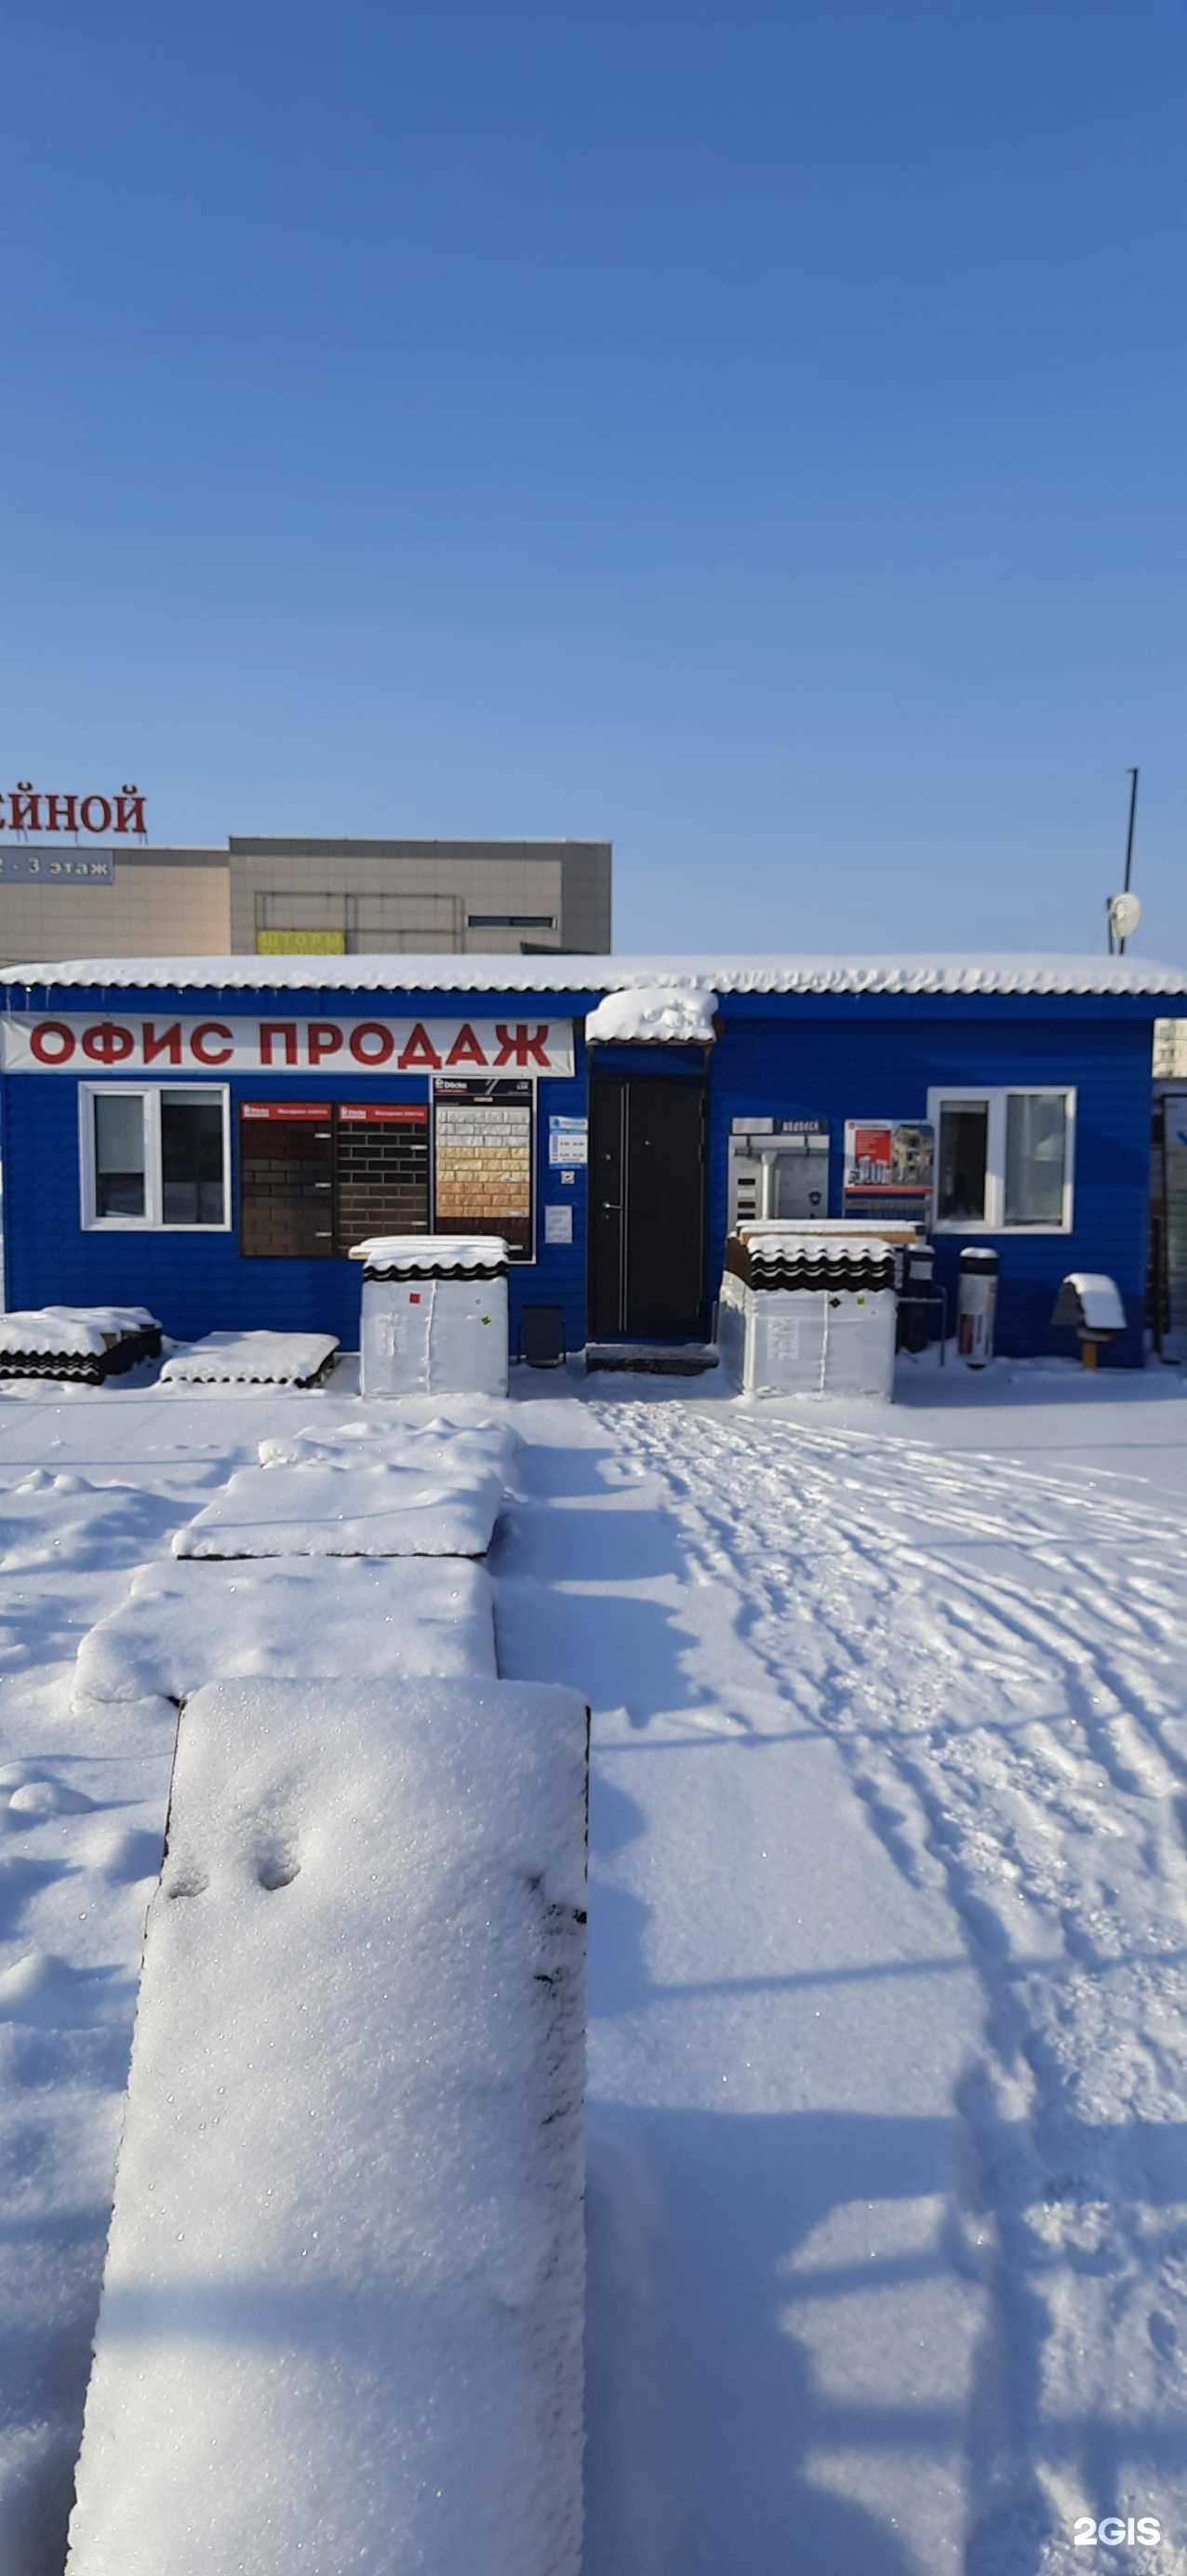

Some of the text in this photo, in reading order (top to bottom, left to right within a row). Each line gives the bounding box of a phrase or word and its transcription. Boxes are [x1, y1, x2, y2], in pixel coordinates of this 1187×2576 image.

[28, 857, 40, 874] 3
[49, 862, 109, 877] этаж
[30, 1022, 552, 1069] ОФИС ПРОДАЖ
